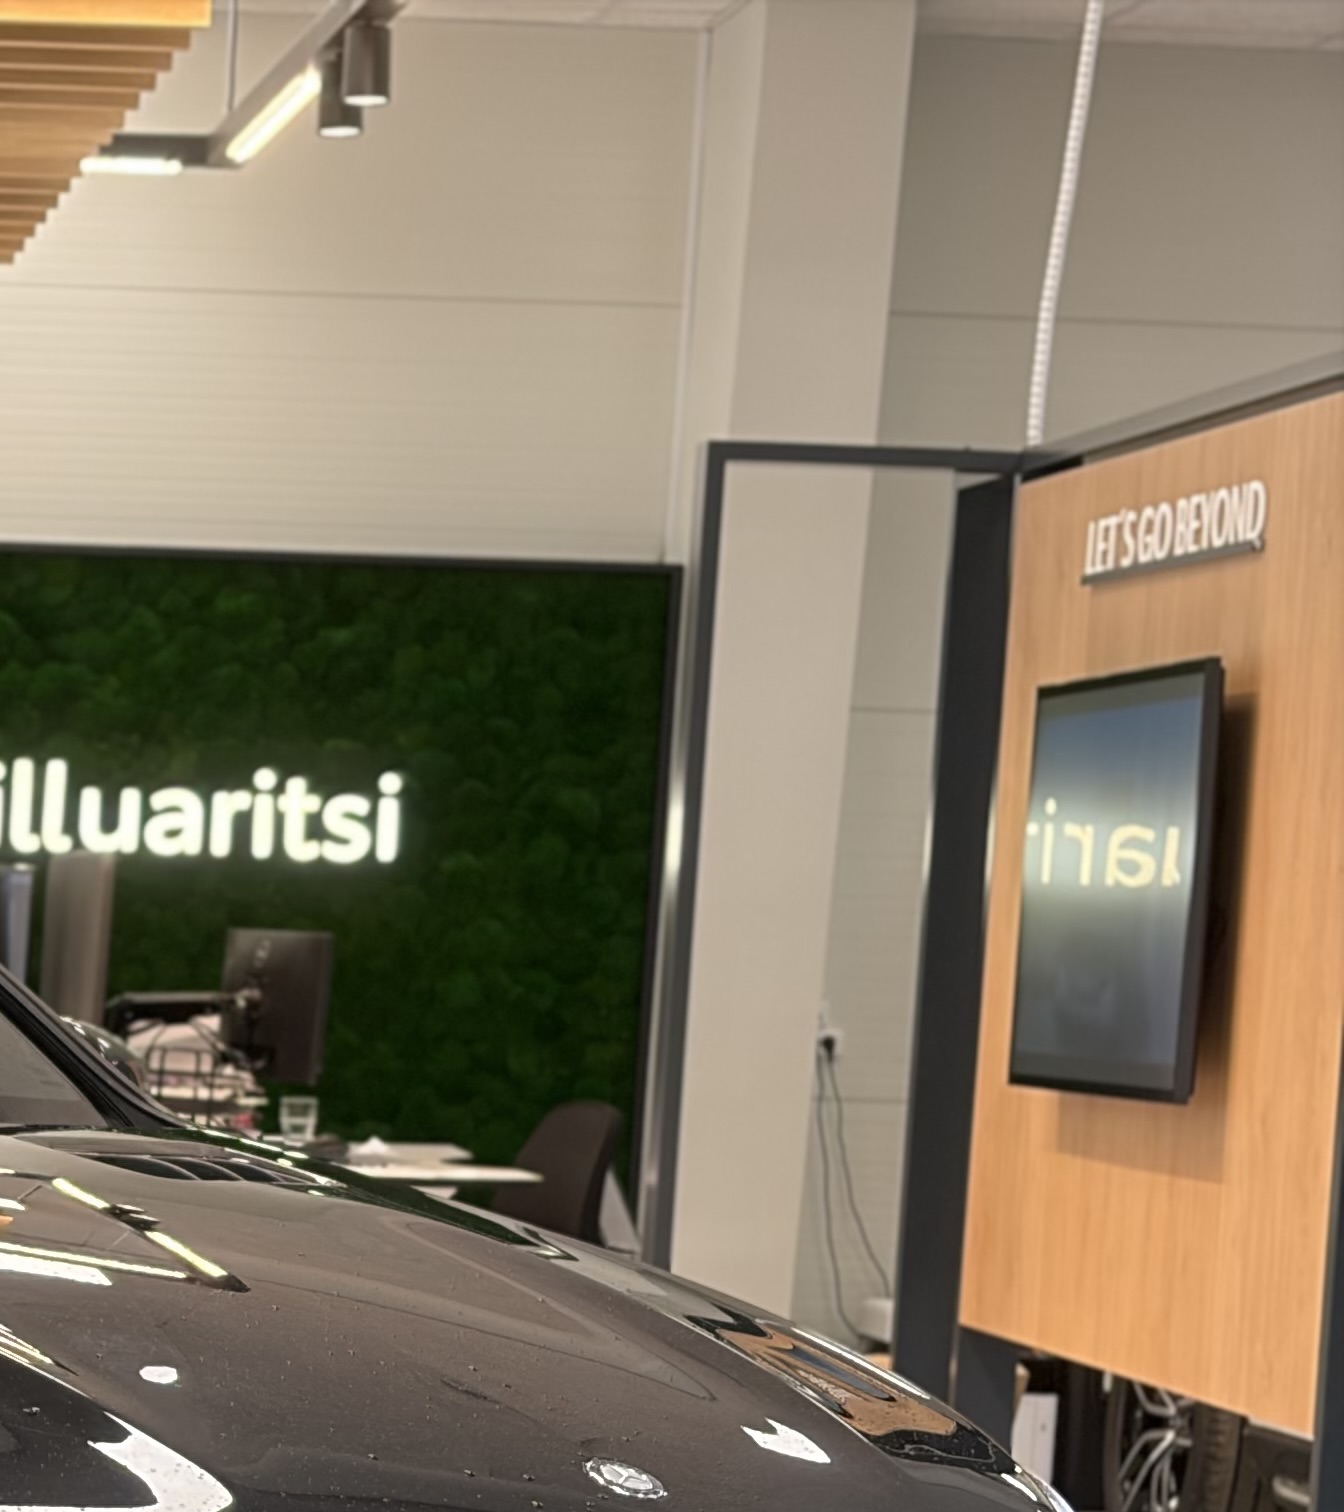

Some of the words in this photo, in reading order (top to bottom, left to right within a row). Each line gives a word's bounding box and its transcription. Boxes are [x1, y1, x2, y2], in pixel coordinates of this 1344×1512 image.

[1084, 508, 1138, 576] LET'S
[1137, 502, 1173, 564] GO
[1173, 480, 1267, 557] BEYOND
